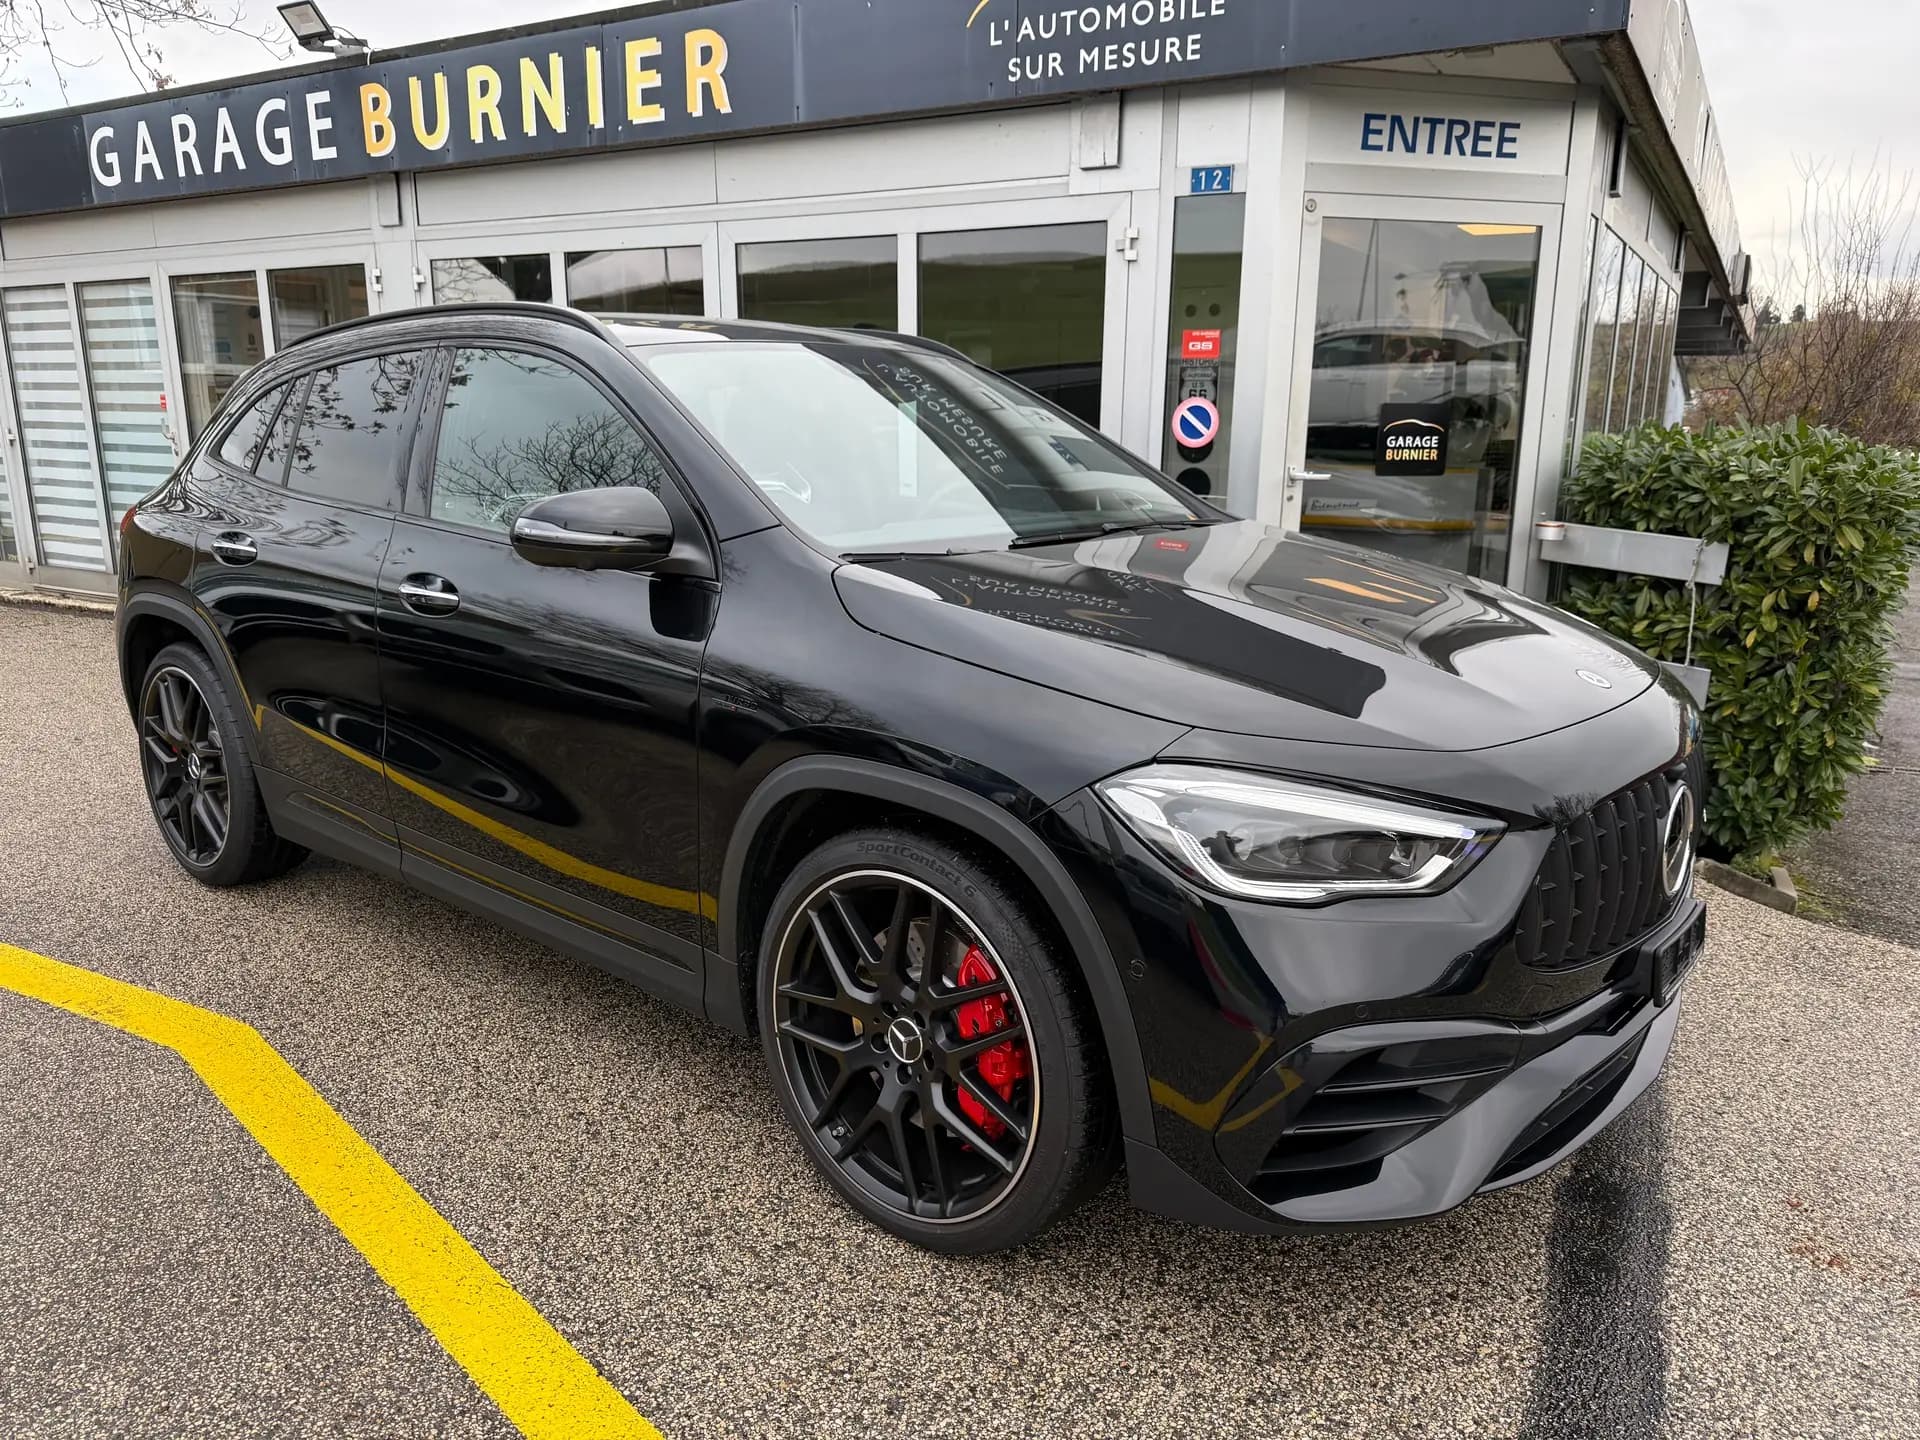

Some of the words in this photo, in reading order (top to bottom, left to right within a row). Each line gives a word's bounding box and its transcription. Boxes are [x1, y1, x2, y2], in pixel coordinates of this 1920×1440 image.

[990, 0, 1226, 46] L'AUTOMOBILE
[1008, 52, 1064, 82] SUR
[1079, 33, 1202, 73] MESURE
[89, 90, 338, 188] GARAGE
[360, 28, 732, 157] BURNIER
[1360, 112, 1521, 159] ENTREE
[1198, 168, 1222, 190] 12
[1385, 448, 1438, 461] BURNIER
[1386, 435, 1439, 448] GARAGE
[857, 841, 962, 886] SportContact
[964, 884, 977, 898] 6
